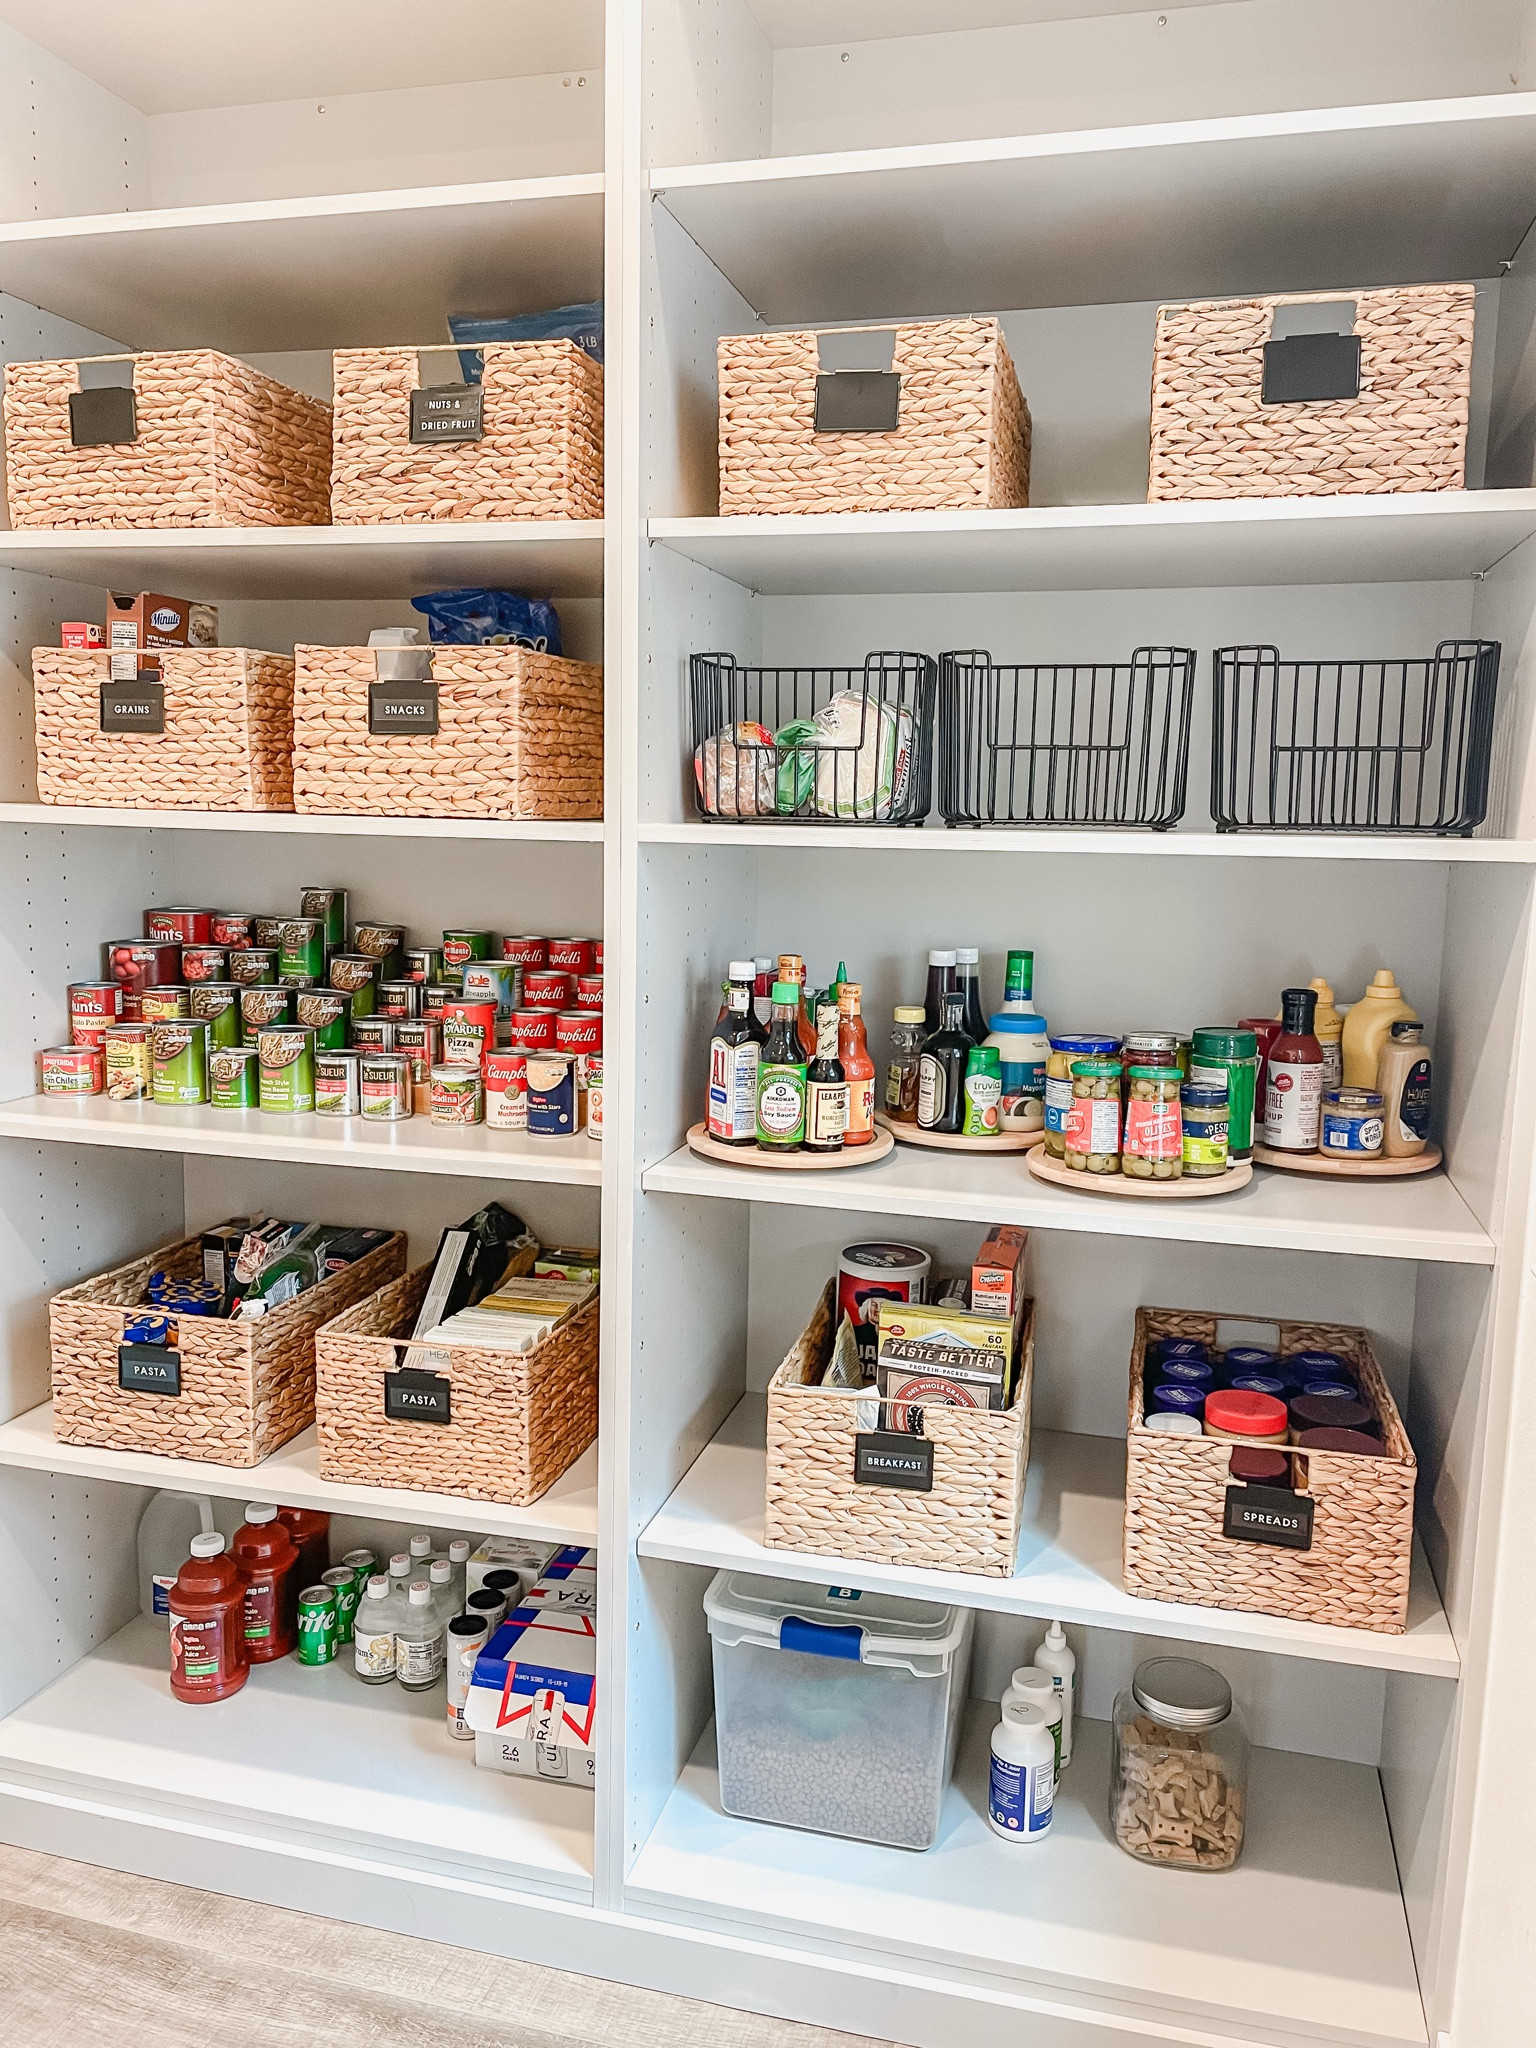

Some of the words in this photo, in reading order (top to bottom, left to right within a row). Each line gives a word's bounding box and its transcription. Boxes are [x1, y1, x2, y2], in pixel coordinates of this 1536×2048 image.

[578, 335, 585, 348] 3
[586, 336, 598, 348] LB
[428, 400, 451, 409] NUTS
[454, 400, 461, 409] &
[421, 421, 448, 430] DRIED
[451, 419, 476, 429] FRUIT
[151, 612, 180, 626] Minute
[114, 704, 150, 714] GRAINS
[384, 705, 425, 715] SNACKS
[548, 951, 580, 965] mpbell's
[468, 975, 490, 986] Dole
[511, 1024, 548, 1038] mpbell's
[447, 1037, 474, 1049] Pizza
[320, 1068, 345, 1077] SUEUR
[369, 1071, 395, 1081] SUEUR
[56, 1075, 79, 1084] Chiles
[1144, 1122, 1172, 1136] OLIVES
[1364, 1130, 1382, 1143] WORLD
[987, 1334, 1003, 1344] 60
[429, 1350, 450, 1360] HEA
[889, 1343, 934, 1361] TASTE
[938, 1350, 995, 1369] BETTER
[134, 1365, 167, 1377] PASTA
[909, 1363, 969, 1378] PROTEIN-PACKED
[402, 1393, 437, 1407] PASTA
[905, 1386, 919, 1398] 100%
[919, 1383, 945, 1391] WHOLE
[946, 1387, 969, 1407] GRAINS
[867, 1456, 922, 1470] BREAKFAST
[1243, 1510, 1299, 1529] SPREADS
[297, 1610, 336, 1633] rite
[502, 1744, 519, 1757] 2.6
[502, 1755, 520, 1763] CARBS
